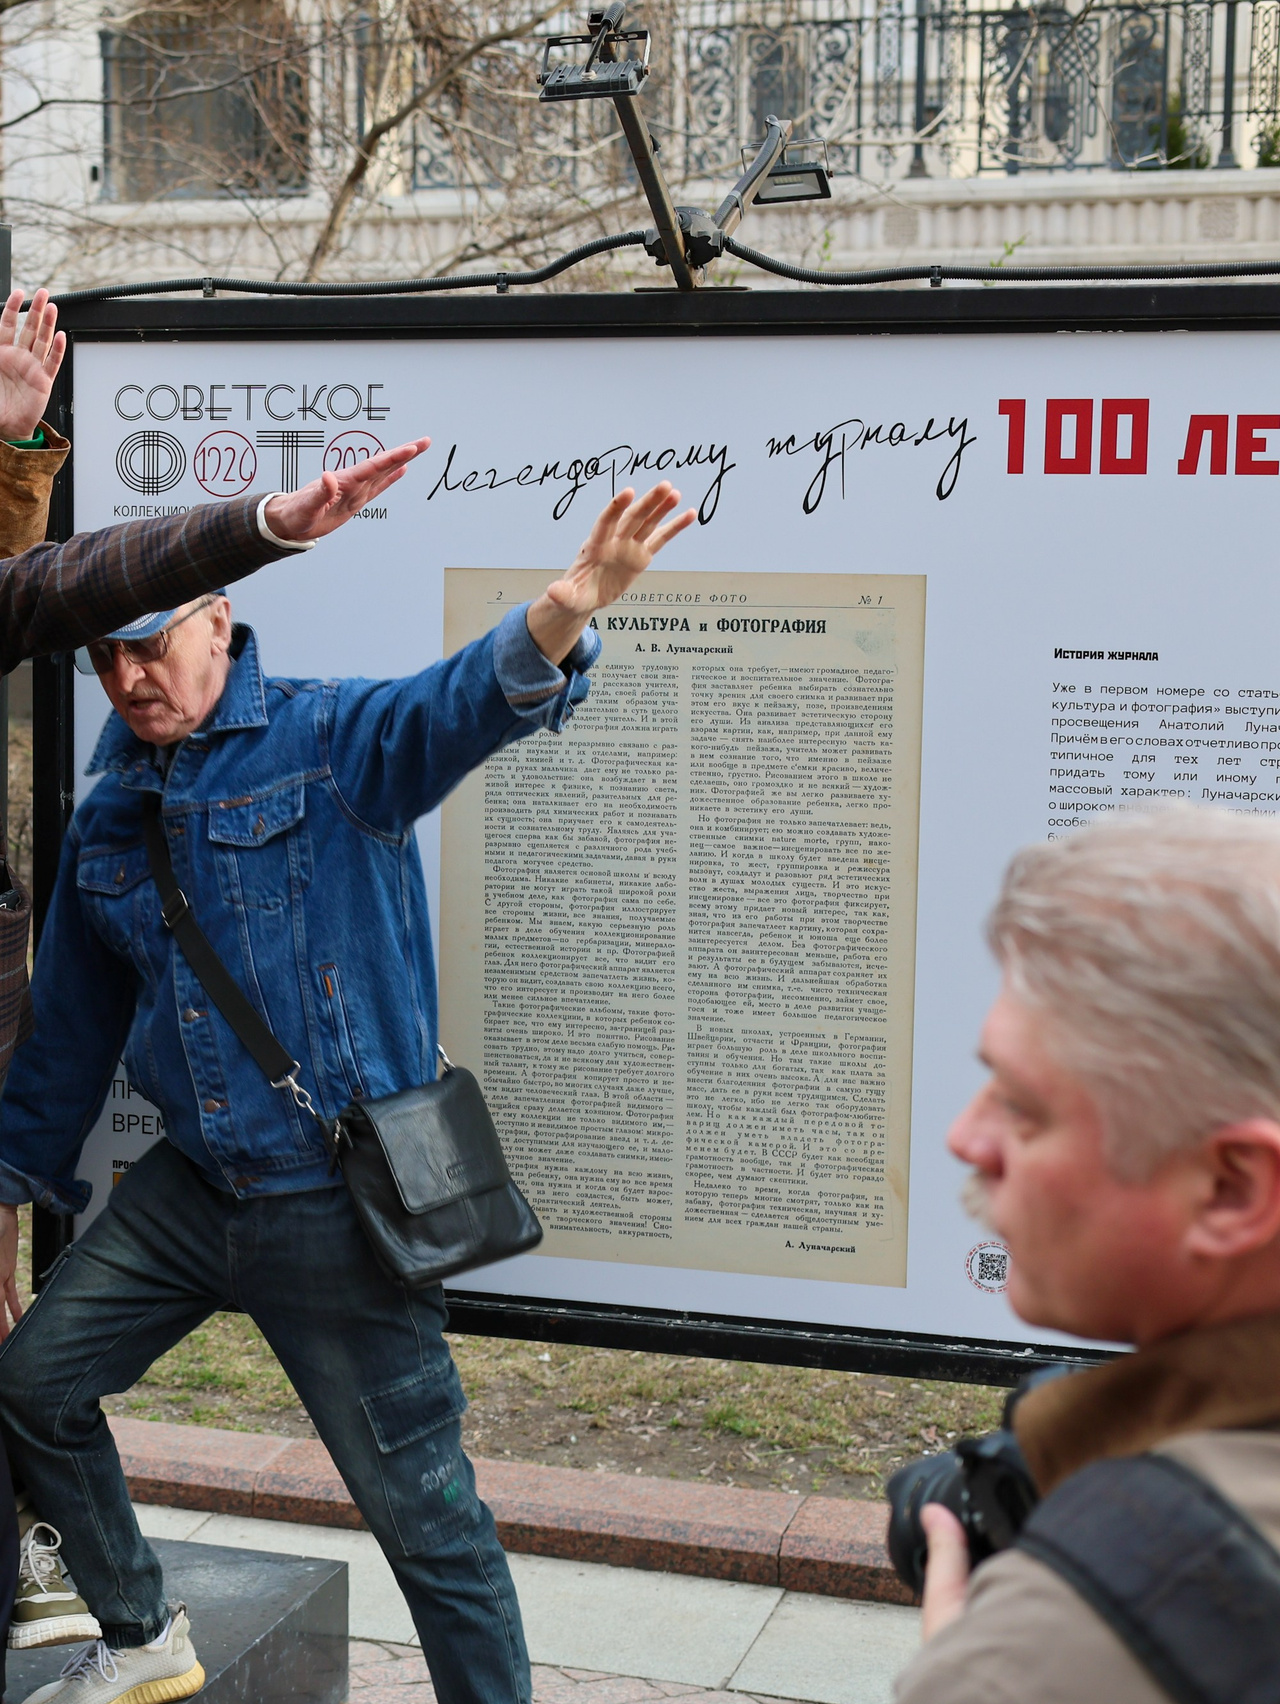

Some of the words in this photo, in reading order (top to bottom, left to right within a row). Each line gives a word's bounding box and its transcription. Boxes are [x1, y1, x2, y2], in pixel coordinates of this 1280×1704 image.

[114, 383, 391, 421] СОВЕТСКОЕ
[765, 417, 978, 514] журналу
[998, 398, 1150, 475] 100
[496, 591, 503, 601] 2
[621, 593, 702, 603] СОВЕТСКОЕ
[709, 594, 747, 603] ФОТО
[607, 617, 691, 632] КУЛЬТУРА
[699, 622, 708, 632] и
[716, 618, 827, 634] ФОТОГРАФИЯ
[635, 643, 646, 653] А.
[650, 643, 661, 653] В.
[666, 643, 734, 656] Луначарский
[1052, 682, 1076, 693] Уже
[1084, 685, 1092, 693] в
[1100, 686, 1148, 700] первом
[1156, 687, 1205, 699] номере
[1213, 688, 1230, 697] со
[1238, 689, 1280, 698] стать
[1052, 702, 1115, 713] культура
[1120, 703, 1128, 711] и
[1131, 702, 1221, 716] фотография»
[1051, 718, 1139, 730] просвещения
[1159, 719, 1224, 731] Анатолий
[1245, 722, 1280, 735] Луна
[1050, 733, 1098, 744] Причём
[1109, 737, 1134, 746] его
[1135, 738, 1183, 747] словах
[1186, 739, 1259, 749] отчетливо
[1050, 751, 1114, 761] типичное
[1132, 754, 1156, 763] для
[1174, 756, 1198, 764] тех
[1217, 757, 1241, 765] лет
[1050, 768, 1105, 779] придать
[1124, 771, 1155, 782] тому
[1174, 773, 1198, 781] или
[1216, 774, 1257, 786] иному
[1049, 784, 1112, 796] массовый
[1120, 787, 1191, 799] характер:
[1059, 803, 1115, 813] широком
[785, 1240, 795, 1248] А.
[798, 1241, 856, 1254] Луначарский
